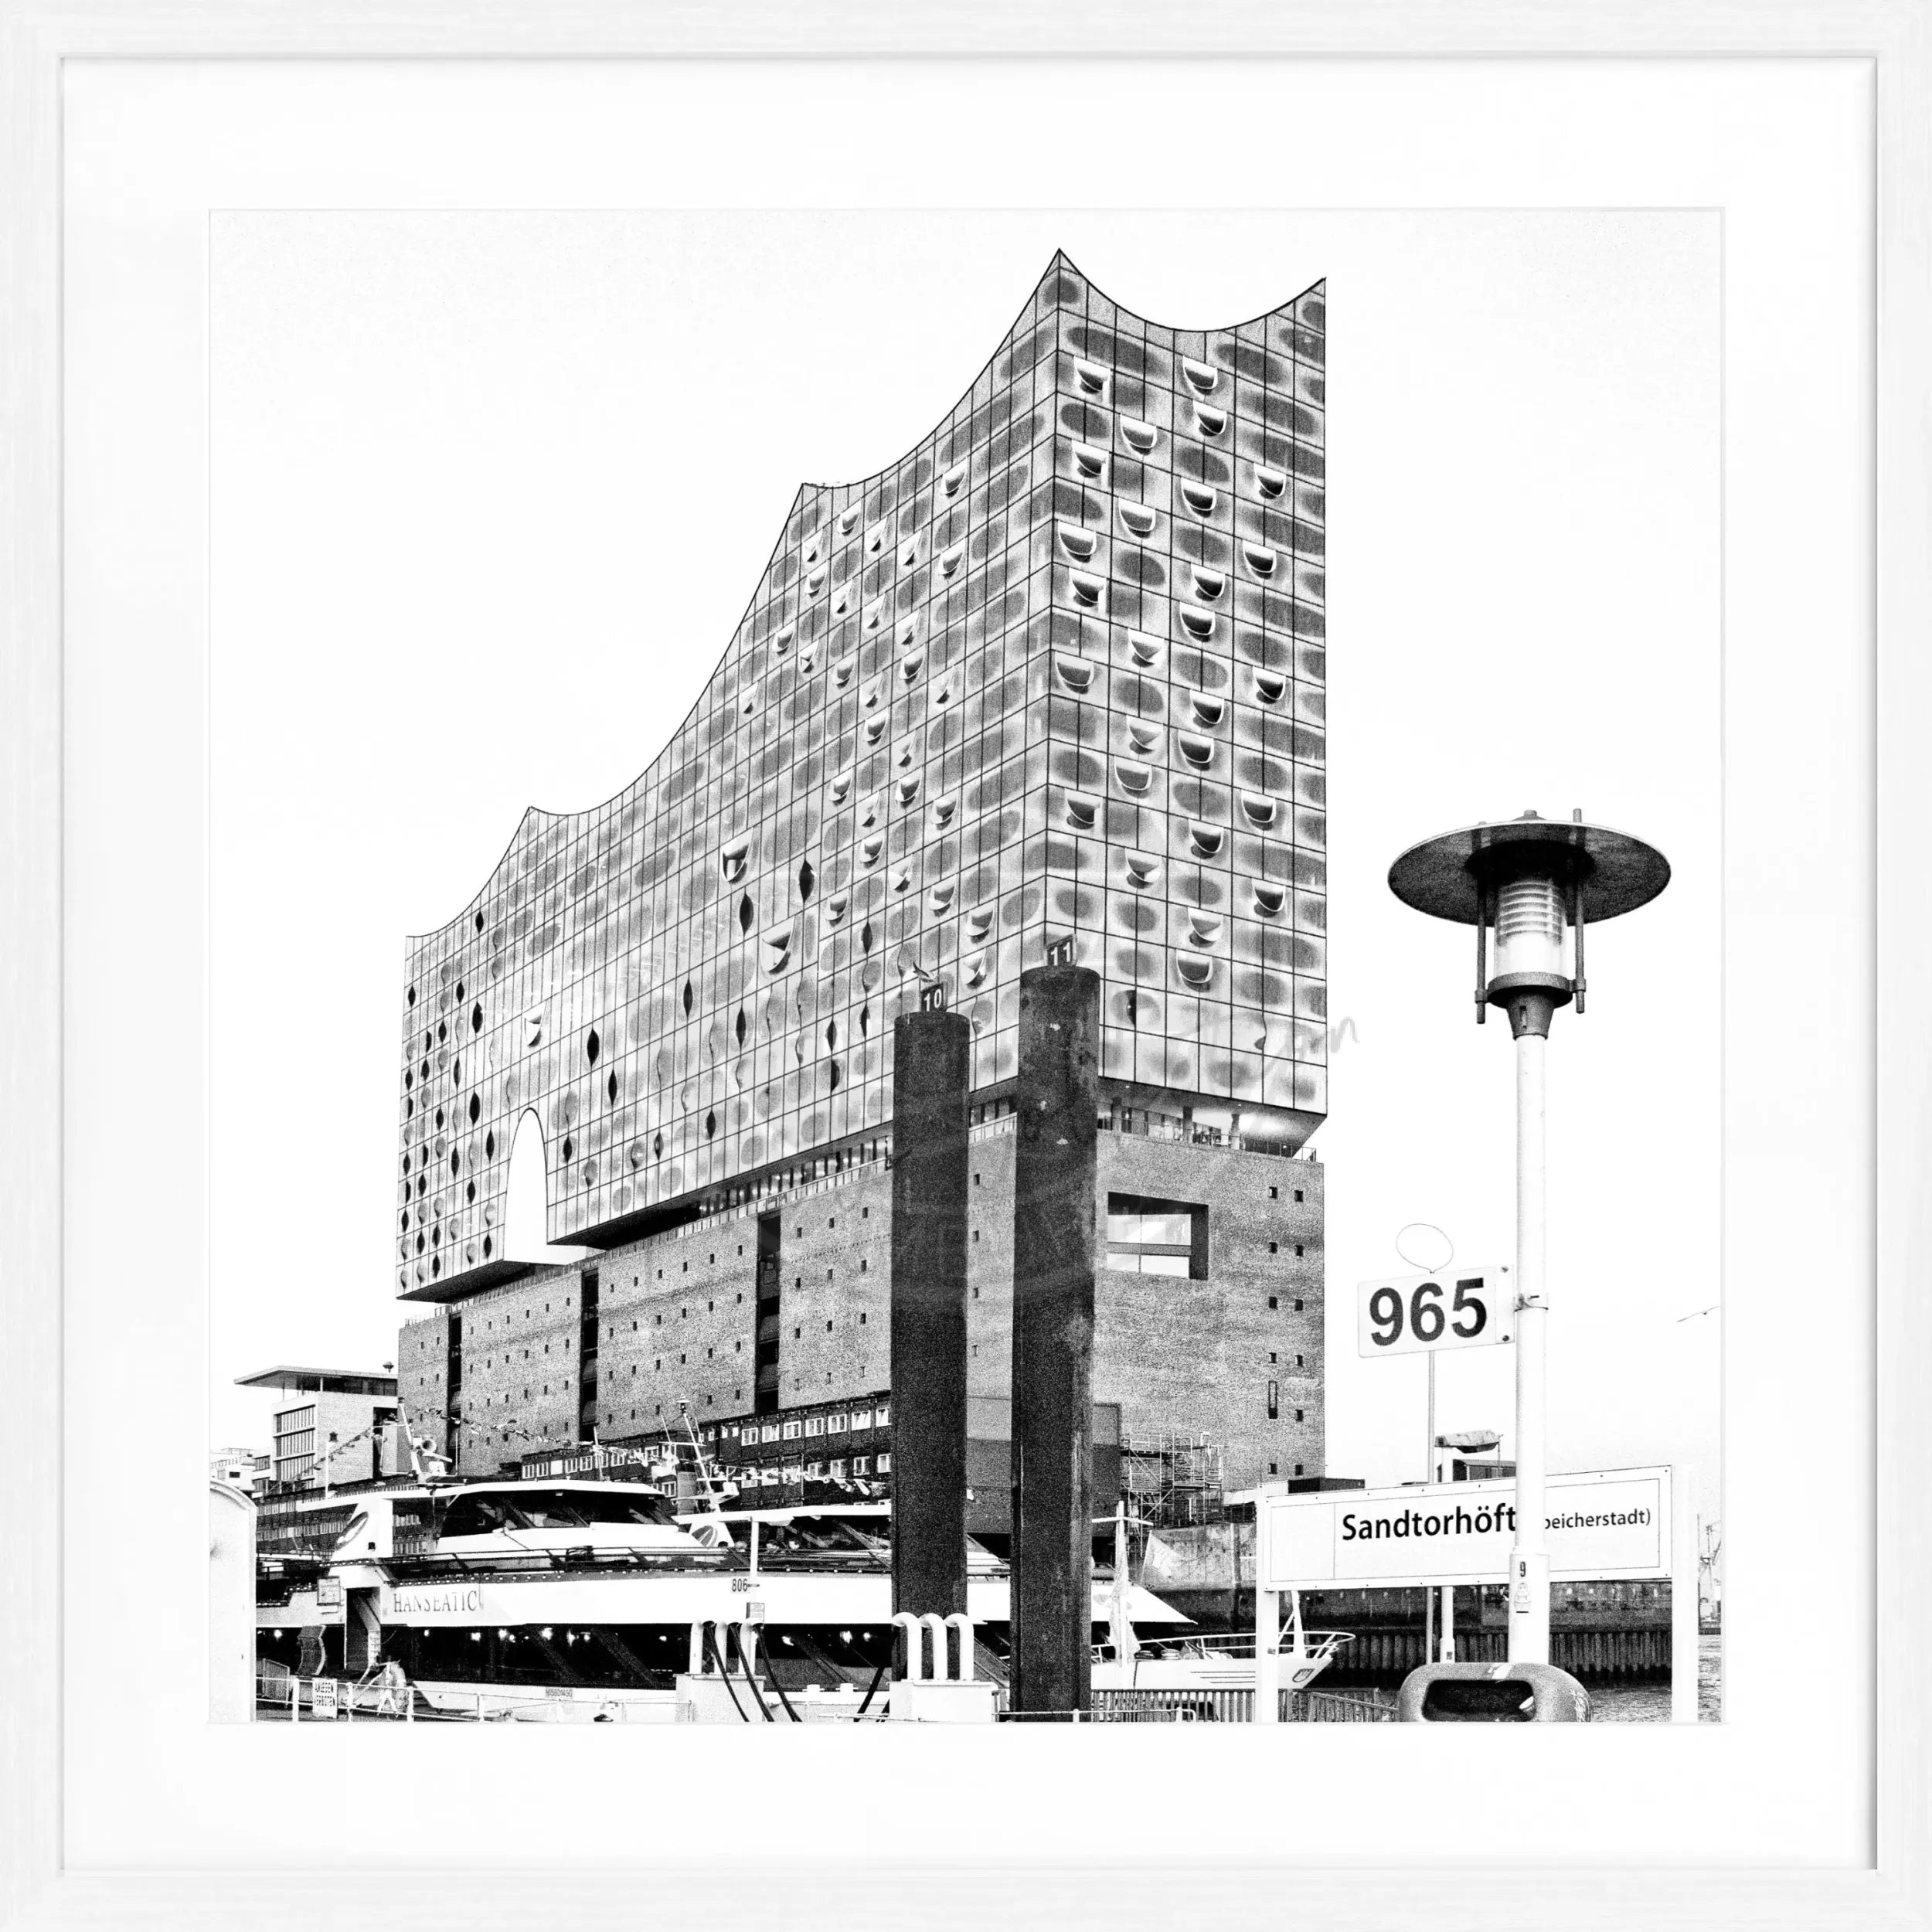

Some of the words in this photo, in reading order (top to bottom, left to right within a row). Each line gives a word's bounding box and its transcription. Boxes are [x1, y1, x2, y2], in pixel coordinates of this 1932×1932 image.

[1050, 941, 1071, 966] 11
[923, 988, 943, 1012] 10
[1369, 1277, 1488, 1346] 965
[1342, 1502, 1516, 1541] Sandtorhöft
[1519, 1561, 1526, 1577] 9
[732, 1578, 748, 1592] 806
[393, 1590, 478, 1613] HANSEATIC
